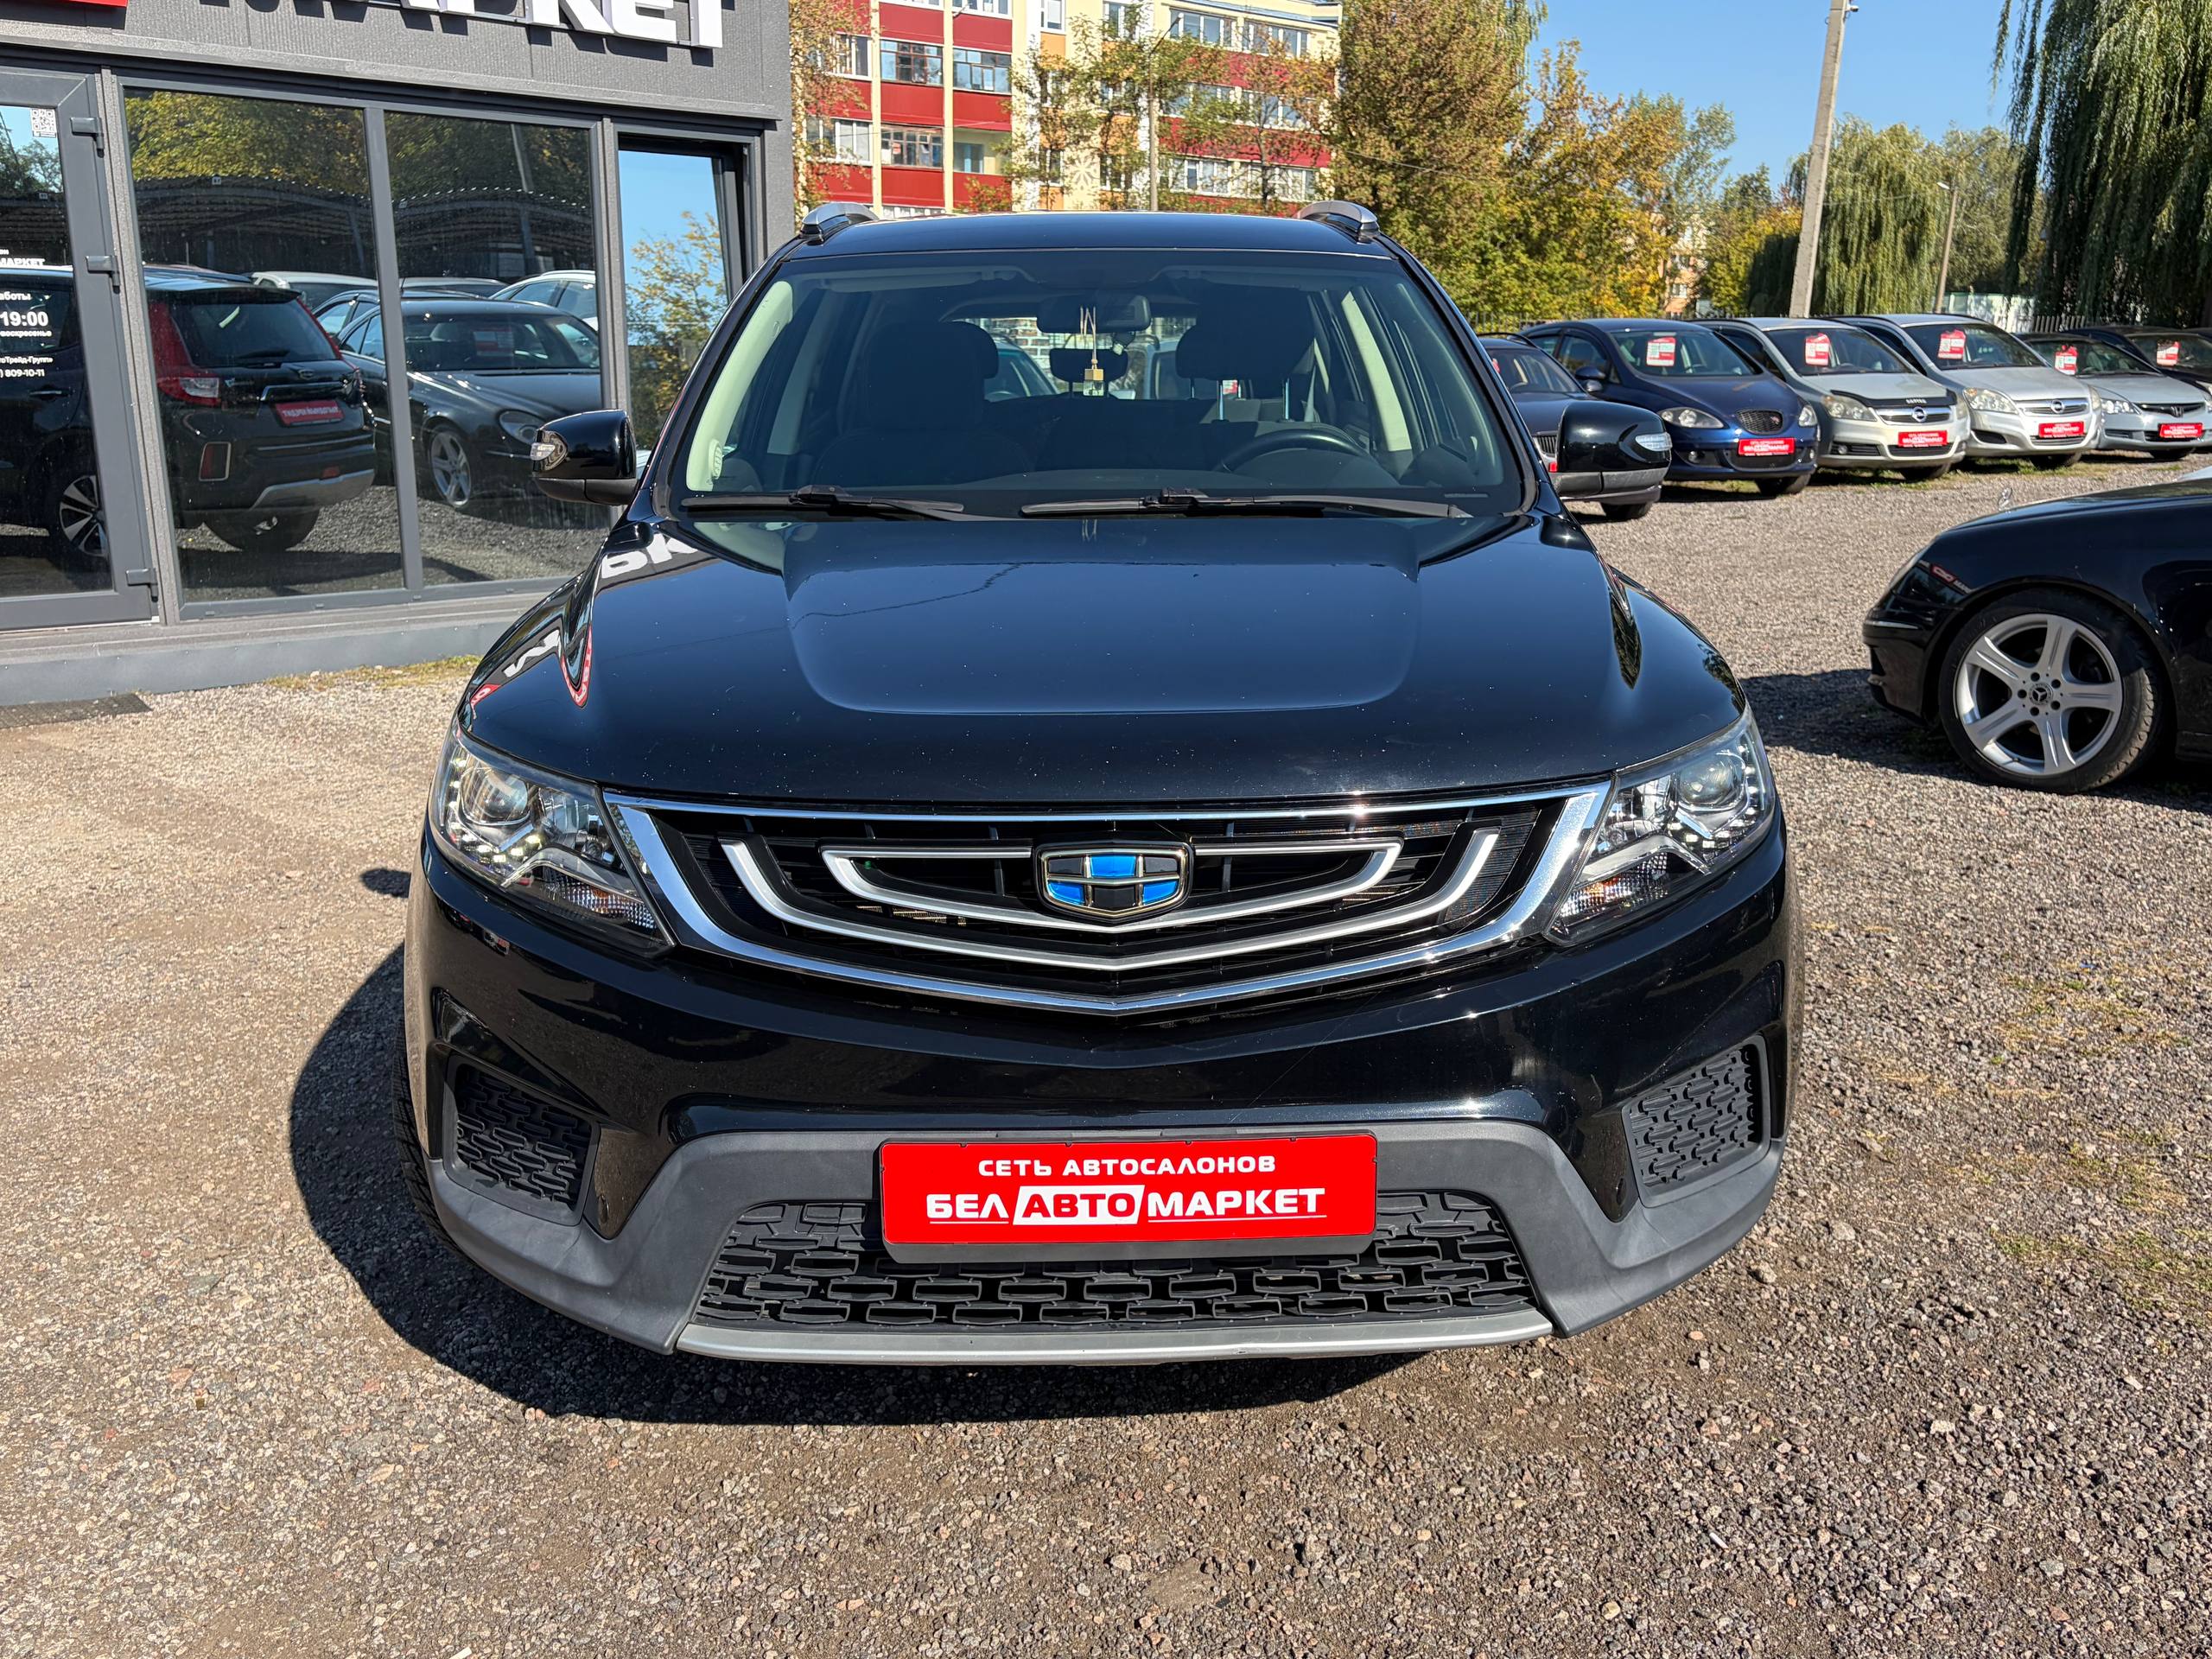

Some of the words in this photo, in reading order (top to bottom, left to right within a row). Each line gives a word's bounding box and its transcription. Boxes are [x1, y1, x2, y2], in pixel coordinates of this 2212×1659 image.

[0, 311, 48, 327] 19:00
[4, 369, 46, 378] 809-10-11
[978, 1160, 1052, 1177] СЕТЬ
[1062, 1155, 1275, 1176] АВТОСАЛОНОВ
